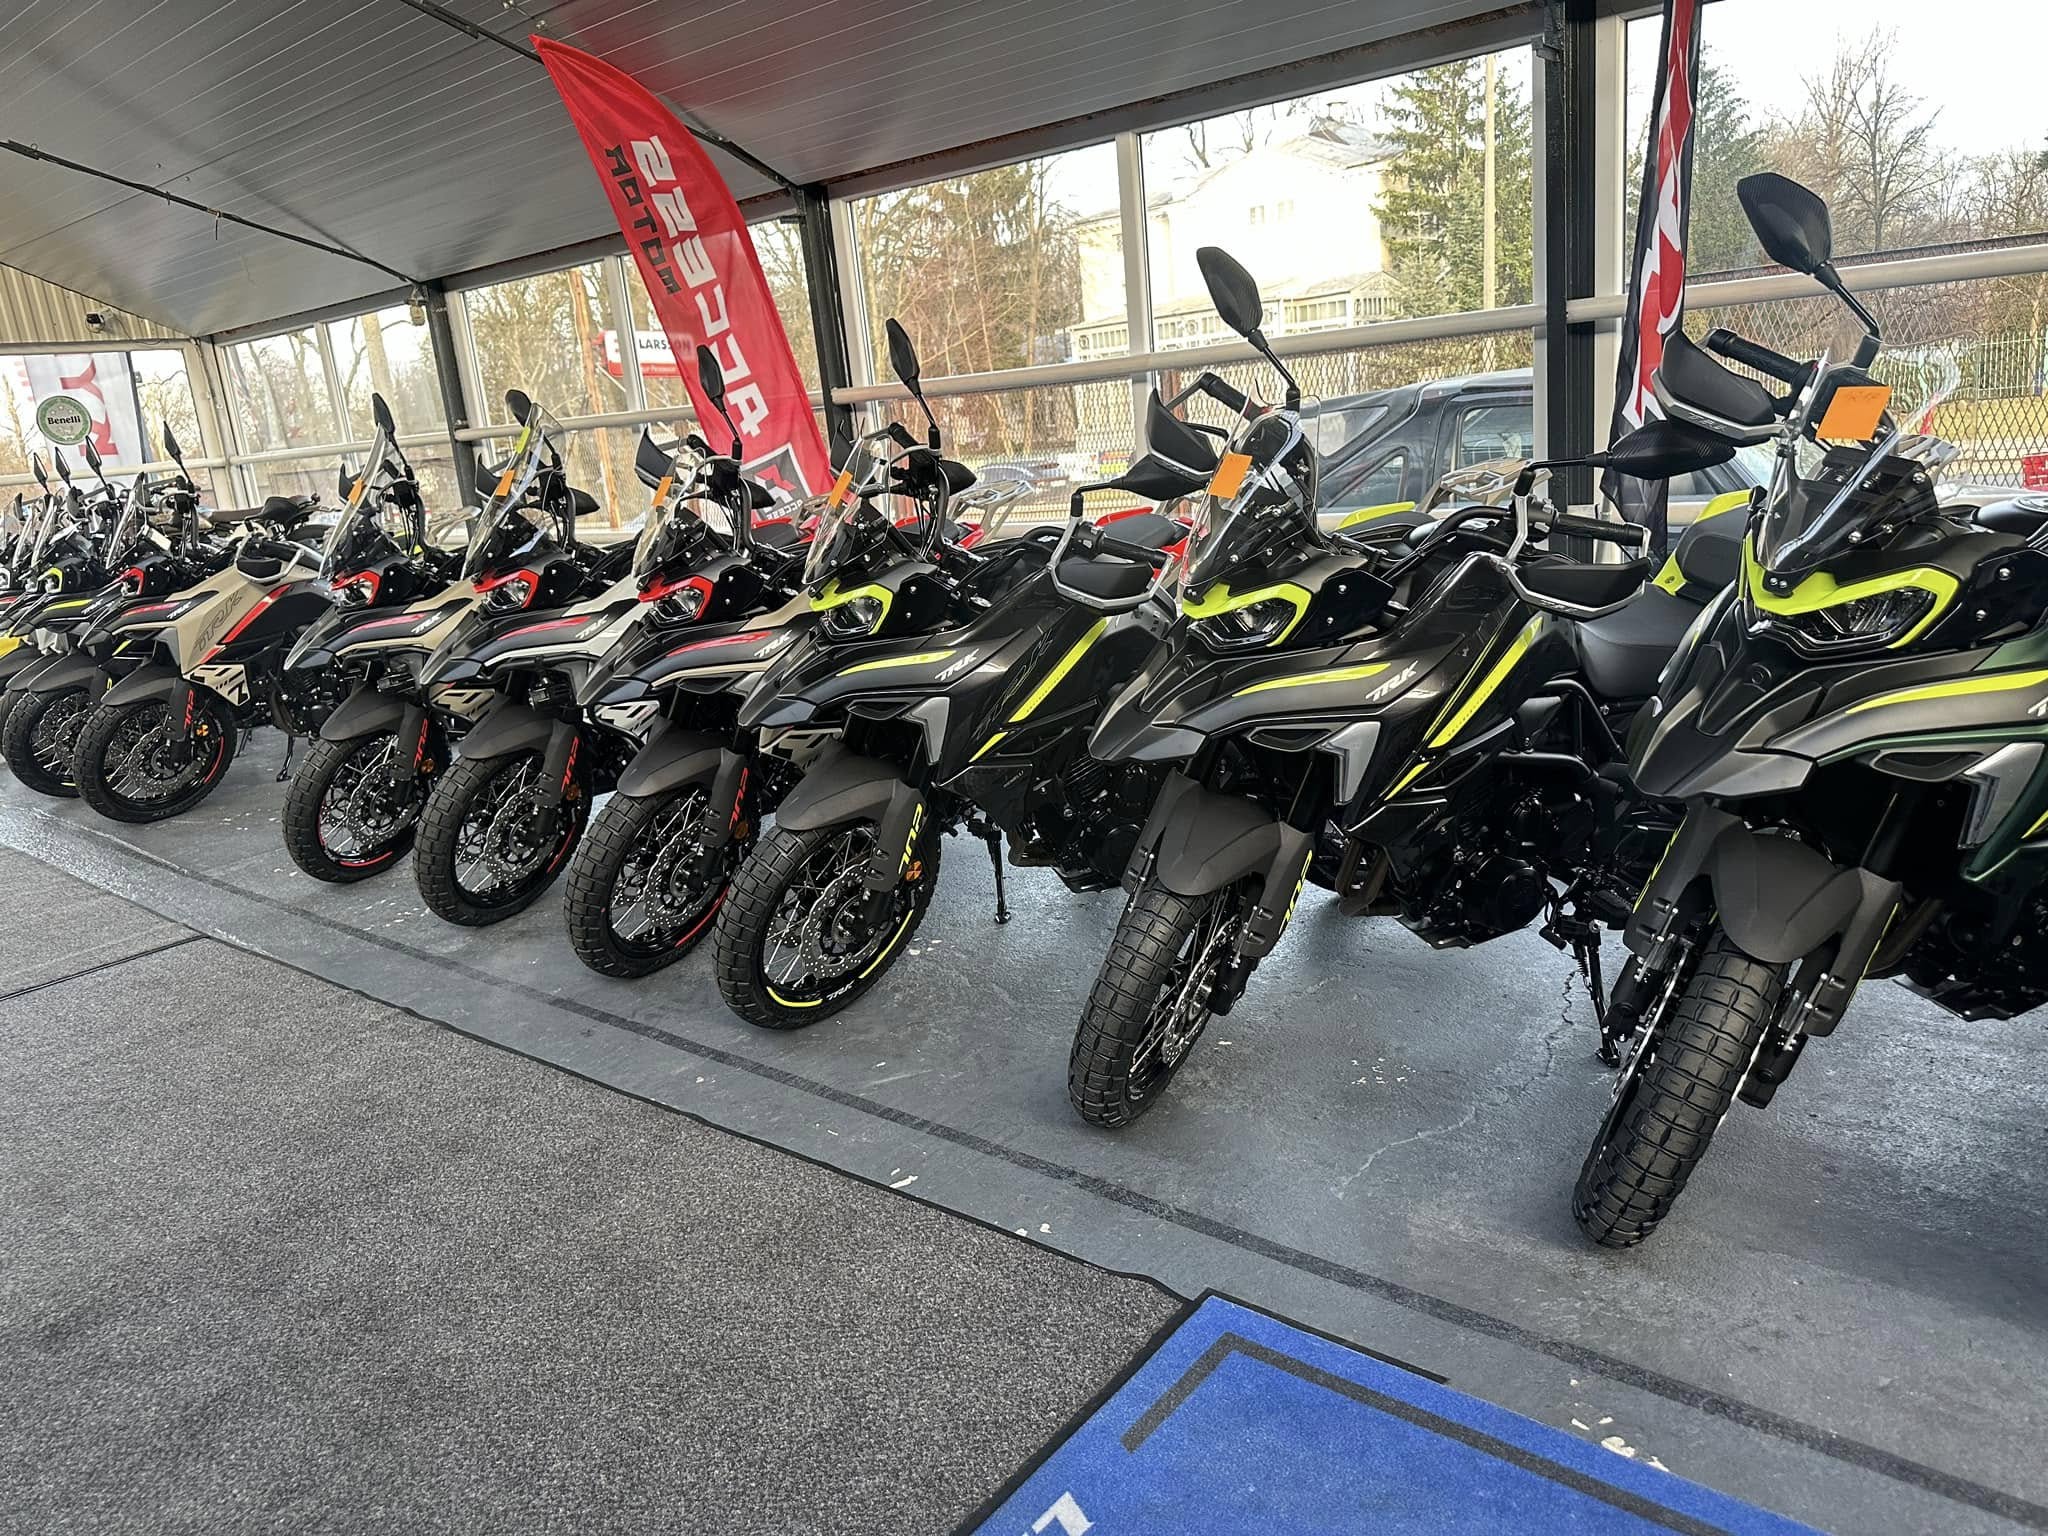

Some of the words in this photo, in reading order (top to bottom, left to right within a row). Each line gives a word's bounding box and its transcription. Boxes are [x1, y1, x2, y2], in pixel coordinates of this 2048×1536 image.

[47, 415, 81, 425] Benelli
[411, 610, 443, 635] TRK
[575, 613, 609, 640] TRK
[754, 629, 793, 658] TRK
[934, 648, 980, 681] TRK
[1365, 660, 1419, 701] TRK
